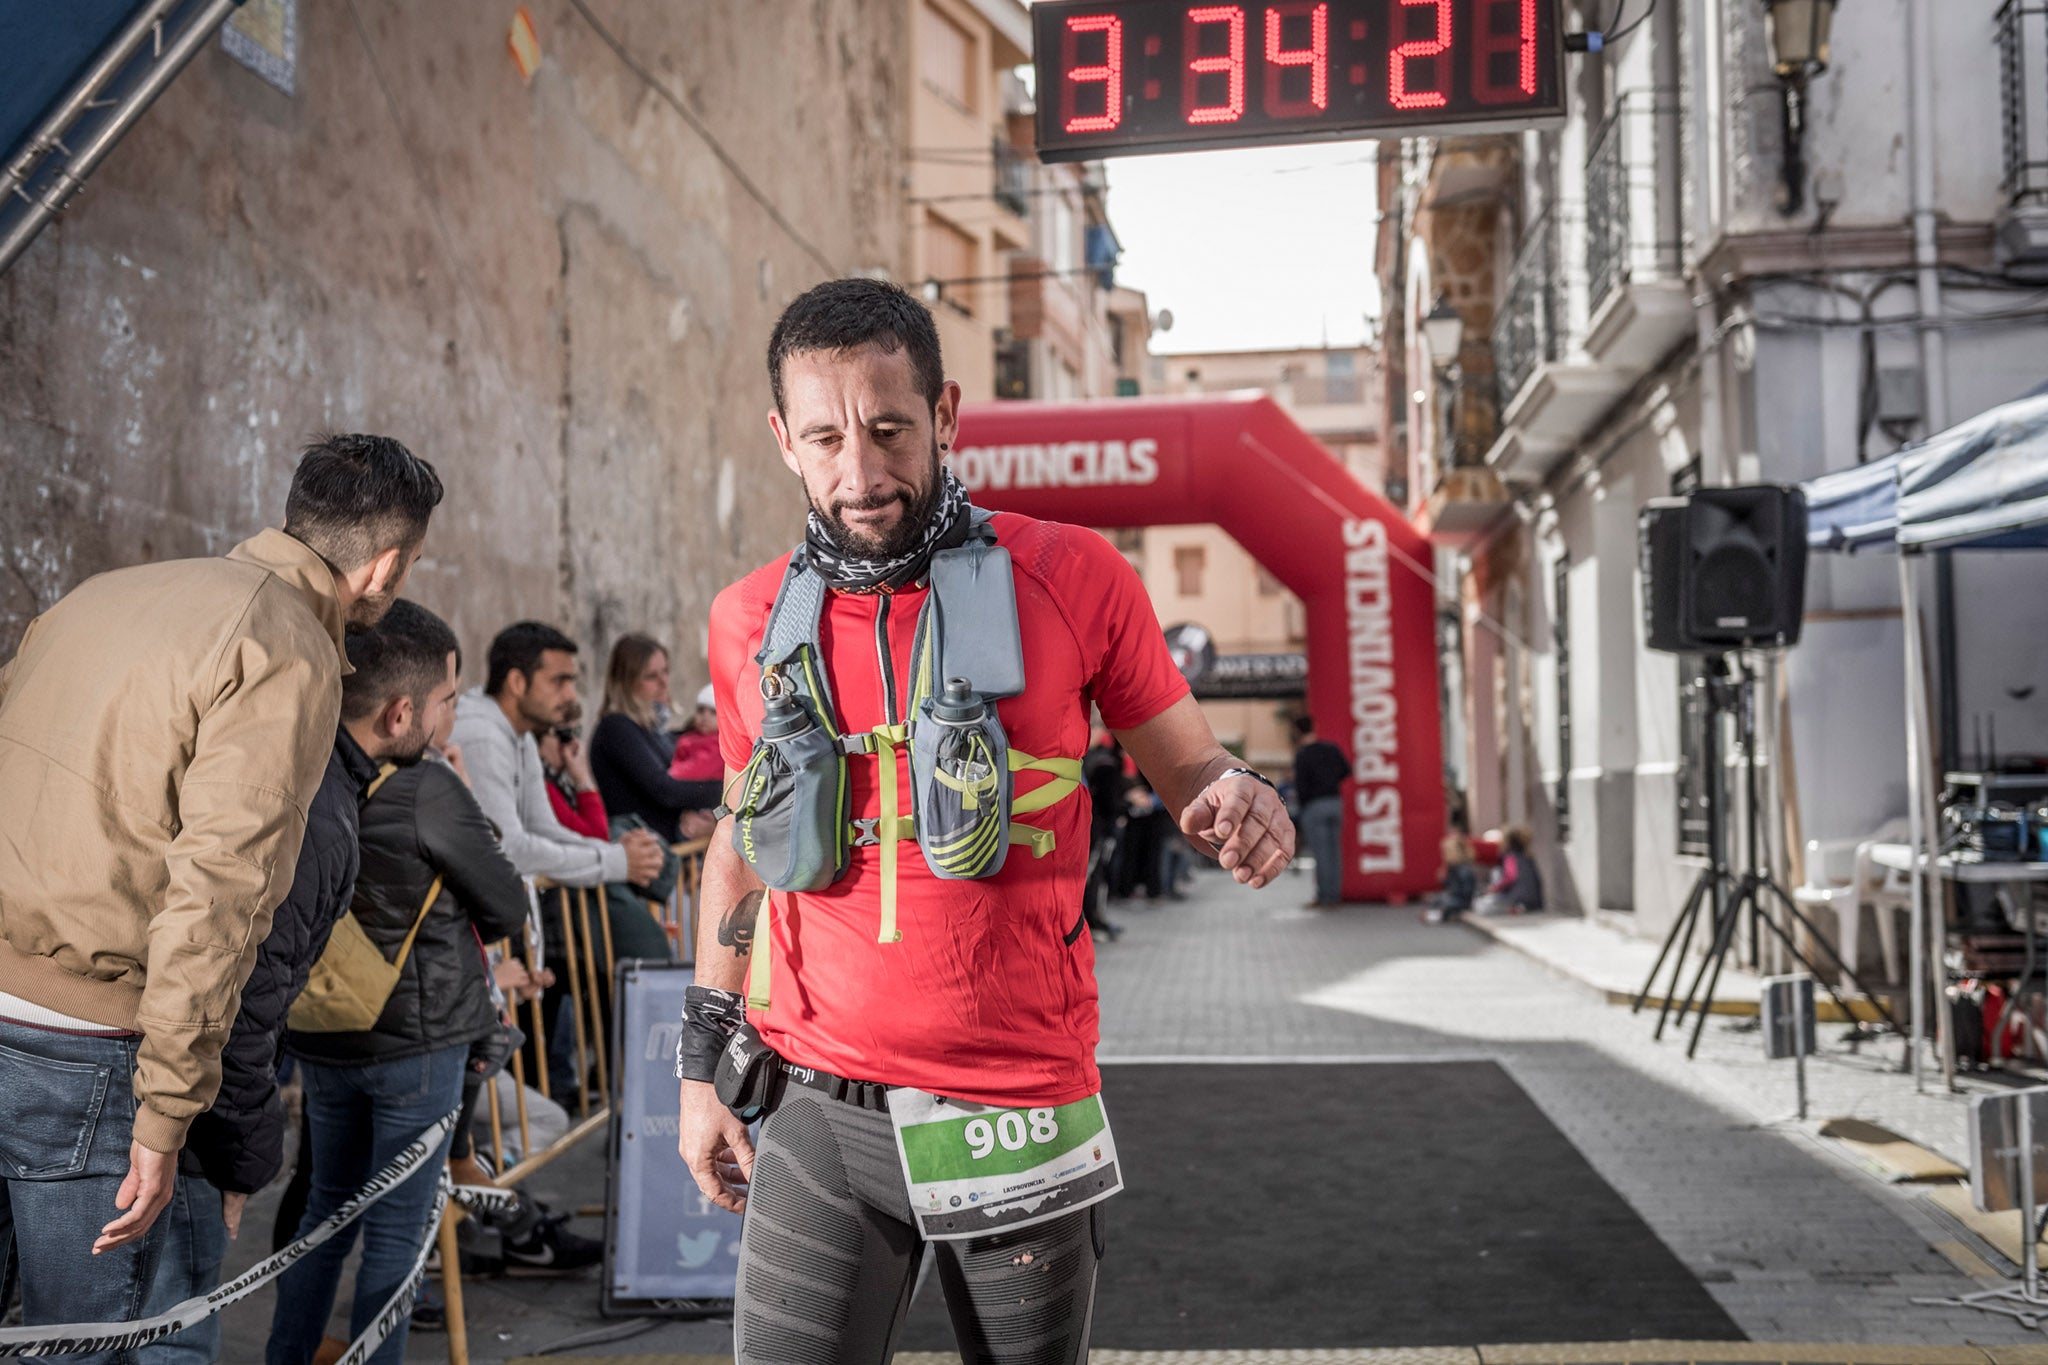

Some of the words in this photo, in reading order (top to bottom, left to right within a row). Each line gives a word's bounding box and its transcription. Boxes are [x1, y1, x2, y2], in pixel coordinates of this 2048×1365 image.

[1343, 518, 1398, 783] PROVINCIAS
[1355, 786, 1404, 873] LAS
[964, 1106, 1059, 1160] 908
